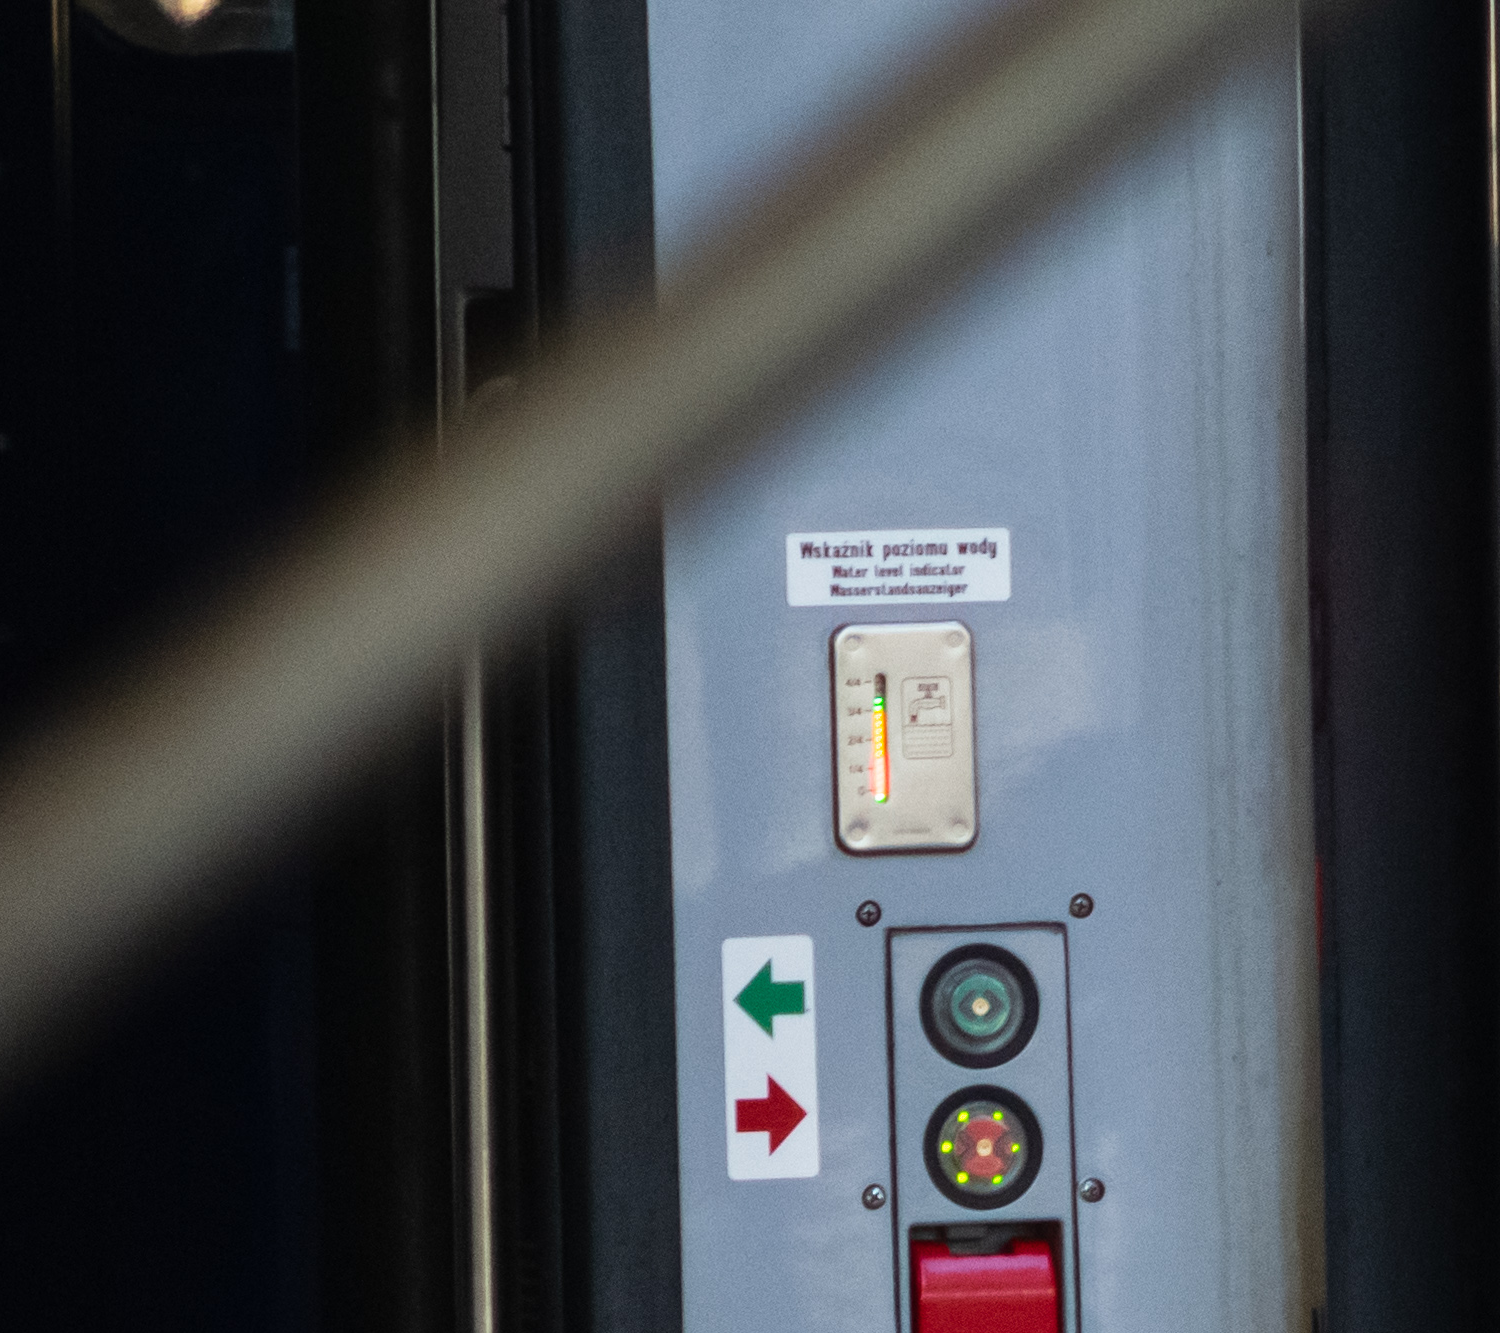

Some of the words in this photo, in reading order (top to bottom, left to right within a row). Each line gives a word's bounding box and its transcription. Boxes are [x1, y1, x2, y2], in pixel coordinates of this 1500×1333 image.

[800, 540, 874, 559] Wskaźnik
[882, 538, 948, 561] poziomu
[956, 537, 997, 559] wody
[832, 565, 868, 579] Water
[874, 564, 903, 578] level
[910, 563, 965, 577] indicator
[830, 583, 968, 598] Wasserstandsanzeiger
